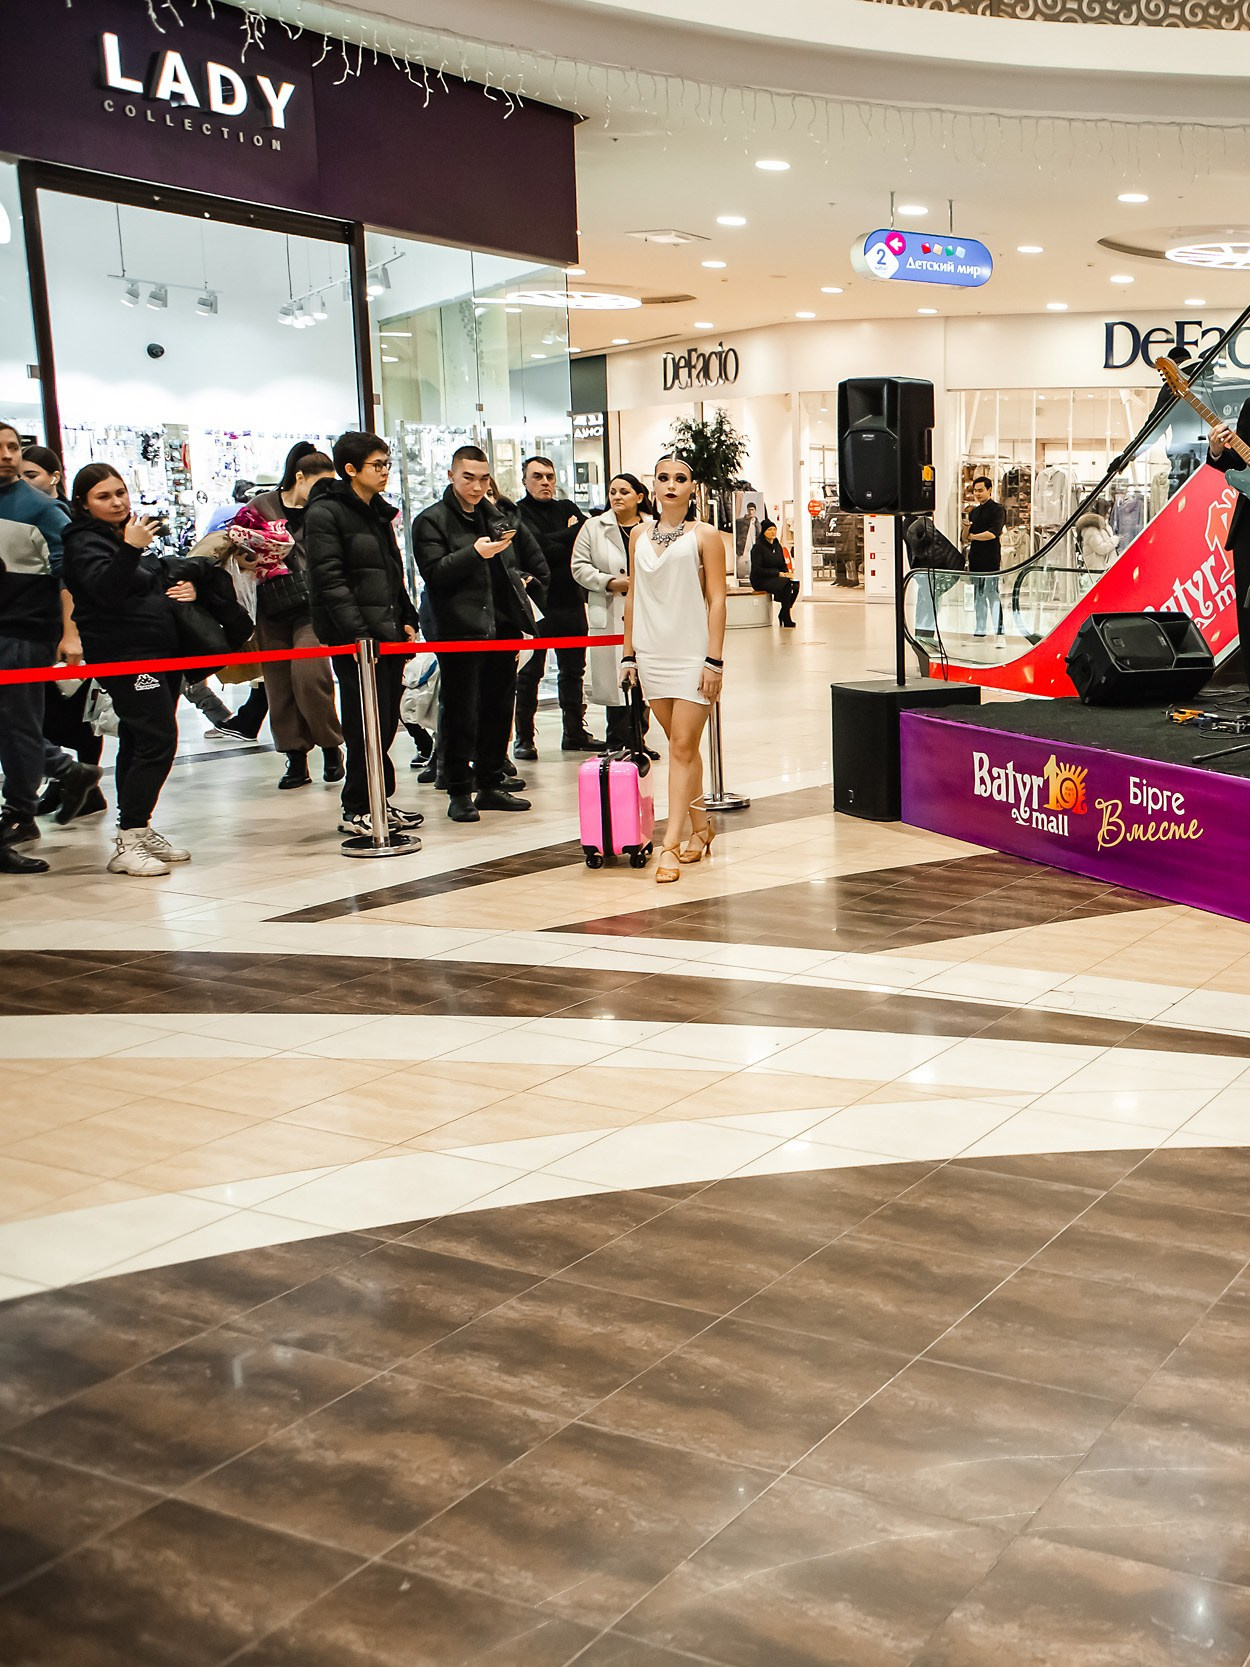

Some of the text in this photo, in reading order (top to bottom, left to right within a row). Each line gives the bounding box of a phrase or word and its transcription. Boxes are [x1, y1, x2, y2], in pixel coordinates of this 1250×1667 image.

[103, 32, 295, 129] LADY
[104, 100, 281, 151] COLLECTION
[876, 248, 887, 266] 2
[906, 257, 981, 279] Детский мир
[662, 341, 739, 391] DeFacto
[973, 751, 1044, 825] Batyr
[1129, 776, 1185, 815] Бірге
[1031, 811, 1069, 837] mall
[1095, 799, 1204, 852] Вместе
